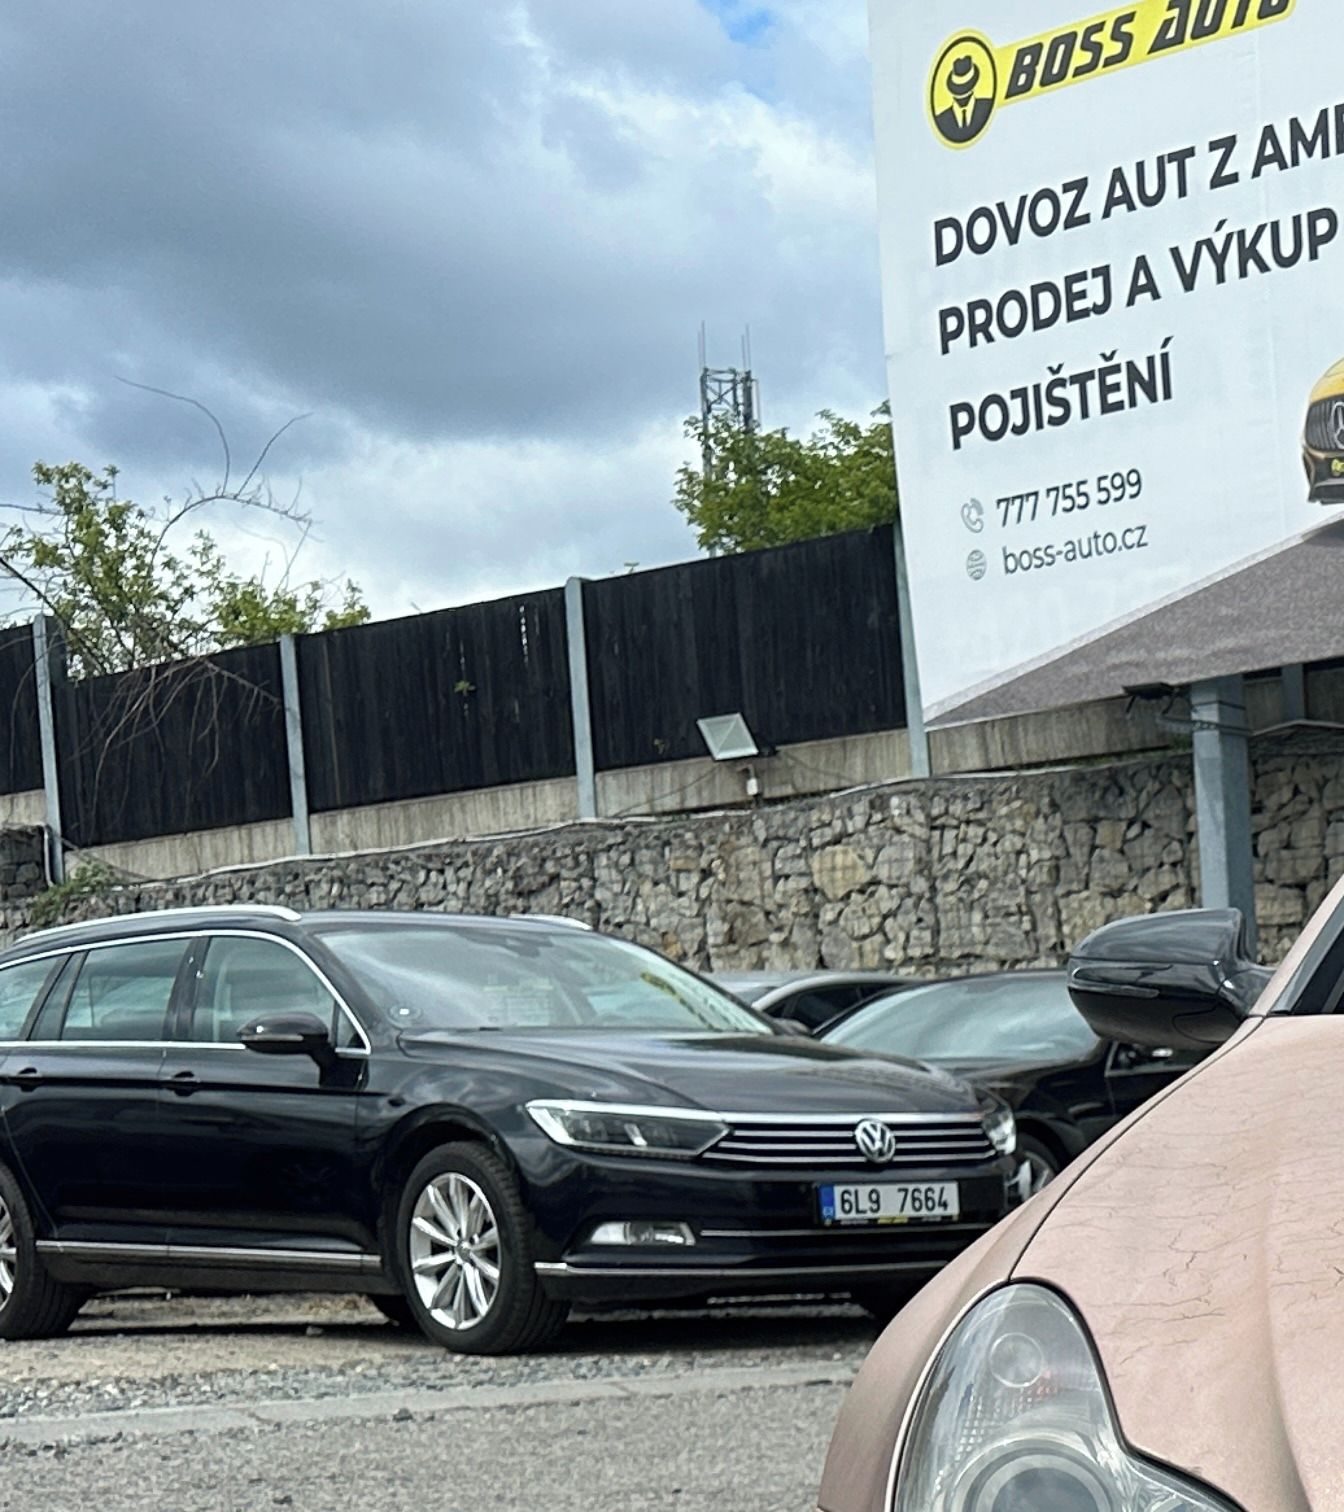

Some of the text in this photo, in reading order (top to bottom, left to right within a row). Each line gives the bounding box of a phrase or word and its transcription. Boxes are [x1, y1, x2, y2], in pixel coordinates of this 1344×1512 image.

[1004, 11, 1137, 99] BOSS
[934, 176, 1091, 266] DOVOZ
[1102, 146, 1196, 219] AUT
[1209, 135, 1239, 190] Z
[938, 207, 1339, 355] PRODEJ A VÝKUP
[949, 336, 1174, 450] POJIŠTĚNÍ
[996, 468, 1142, 527] 777 755 599
[1002, 525, 1148, 575] boss-auto.cz
[840, 1187, 949, 1214] 6L9 7664
